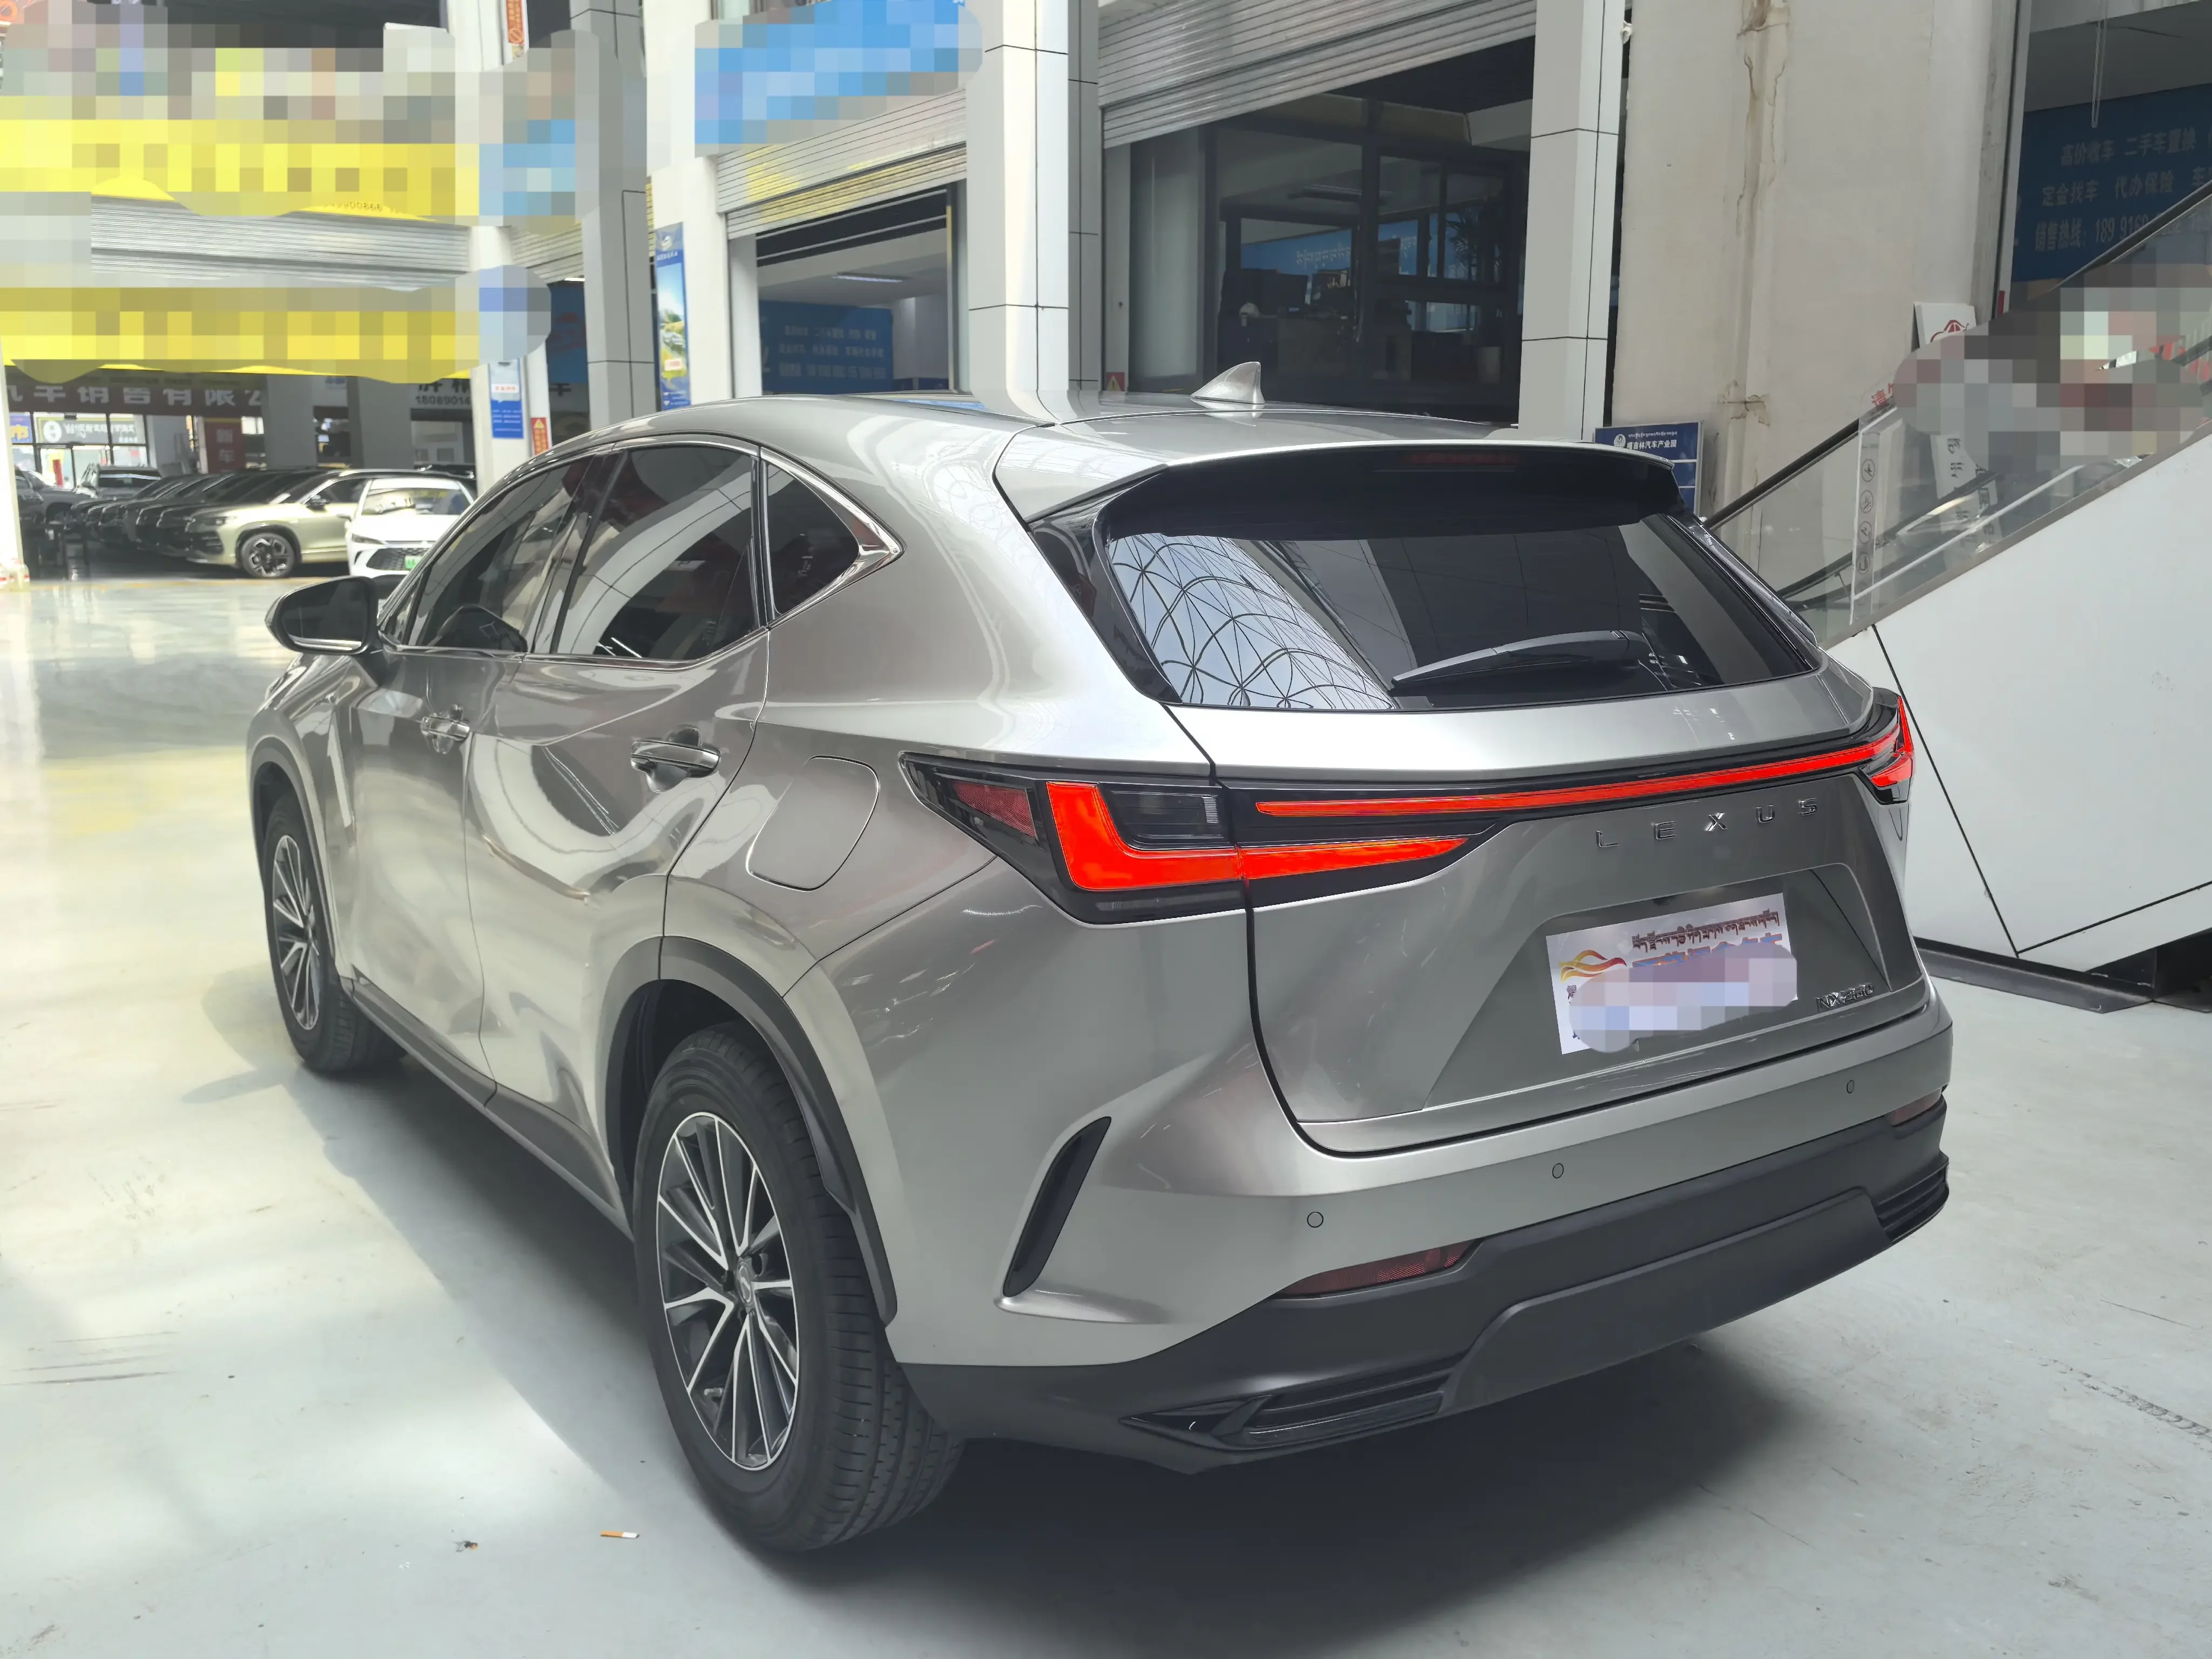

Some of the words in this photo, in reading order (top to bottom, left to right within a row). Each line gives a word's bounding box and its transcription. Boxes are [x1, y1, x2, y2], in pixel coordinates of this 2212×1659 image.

[2061, 139, 2115, 167] 高价收车
[2124, 126, 2196, 157] 二手车置换
[2042, 179, 2098, 206] 定金找车
[2115, 170, 2174, 200] 代办保险
[2191, 166, 2212, 188] 车
[2095, 217, 2115, 243] 189
[1595, 797, 1818, 848] LEXUS
